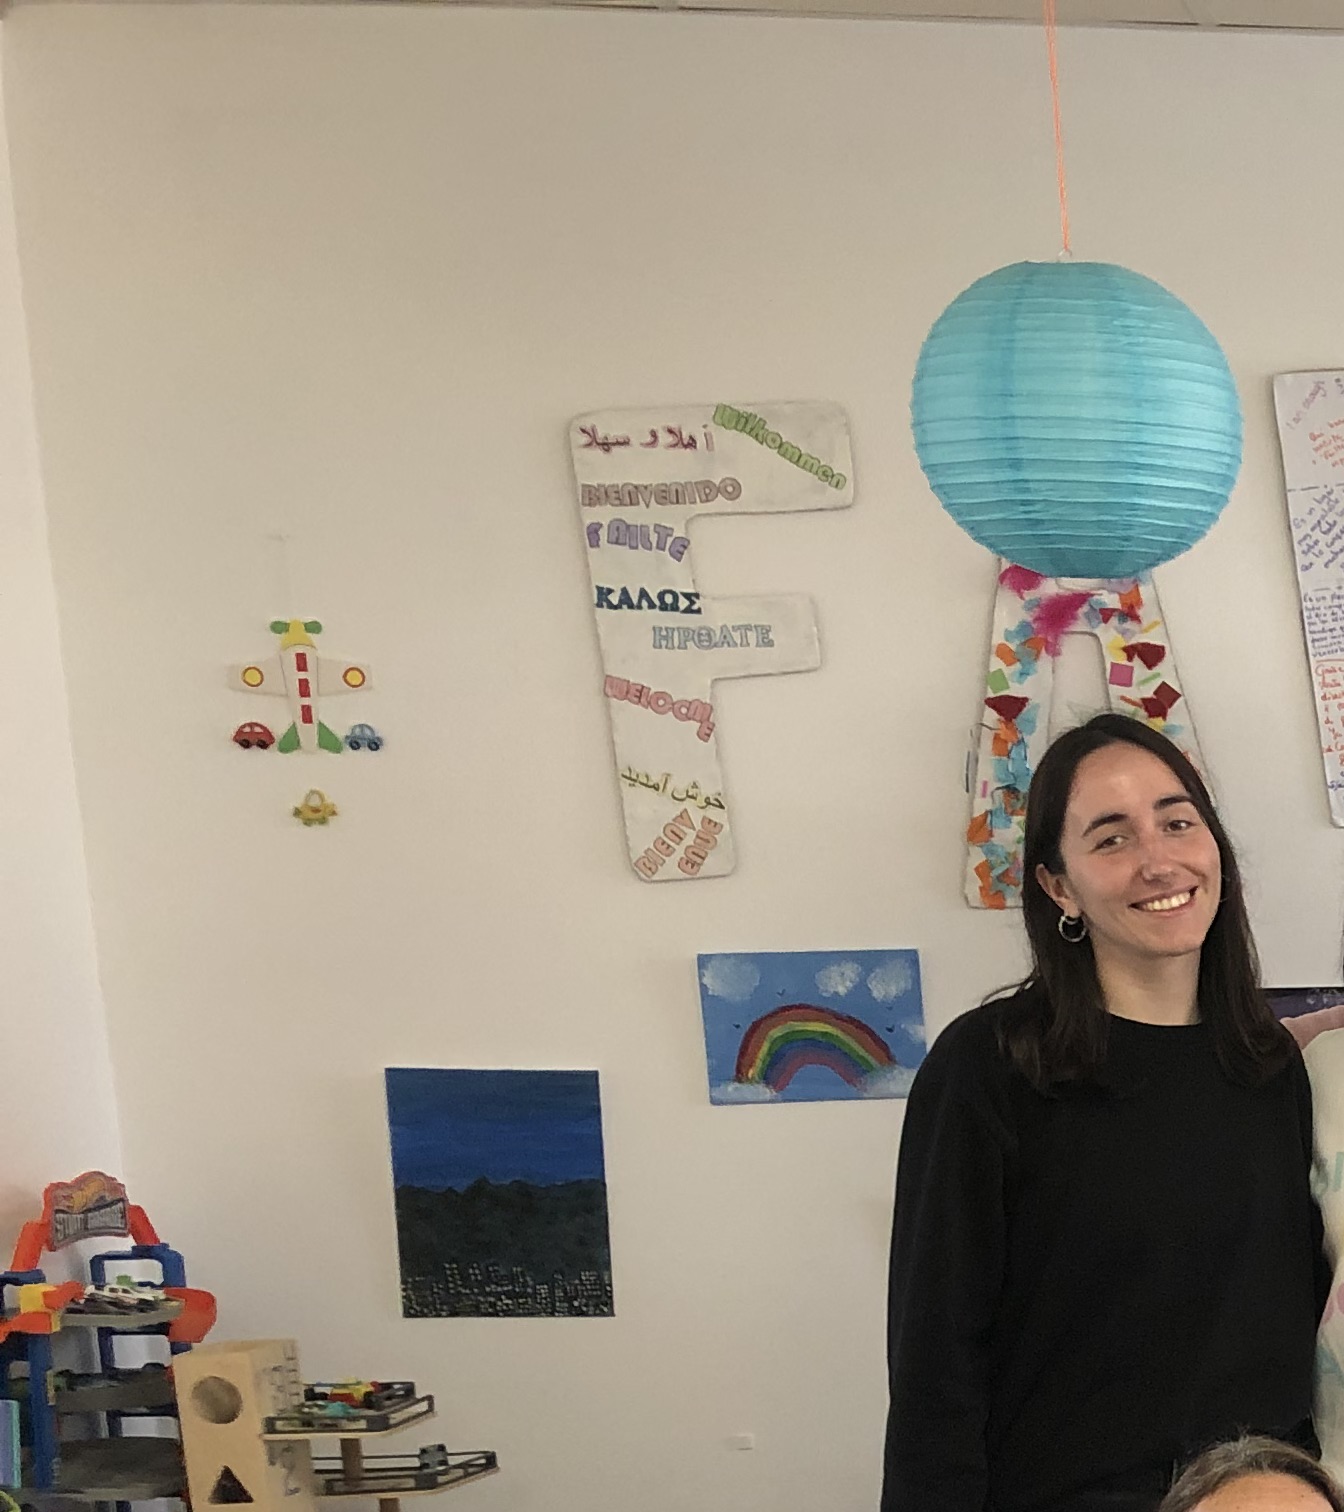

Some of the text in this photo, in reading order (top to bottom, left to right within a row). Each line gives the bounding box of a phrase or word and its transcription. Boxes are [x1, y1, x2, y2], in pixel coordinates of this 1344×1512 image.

[581, 477, 742, 509] BIENVENIDO
[586, 517, 691, 562] FAILTE
[595, 585, 703, 616] ΚΑΛΩΣ
[652, 623, 775, 651] ΗΡΘΑΤΕ
